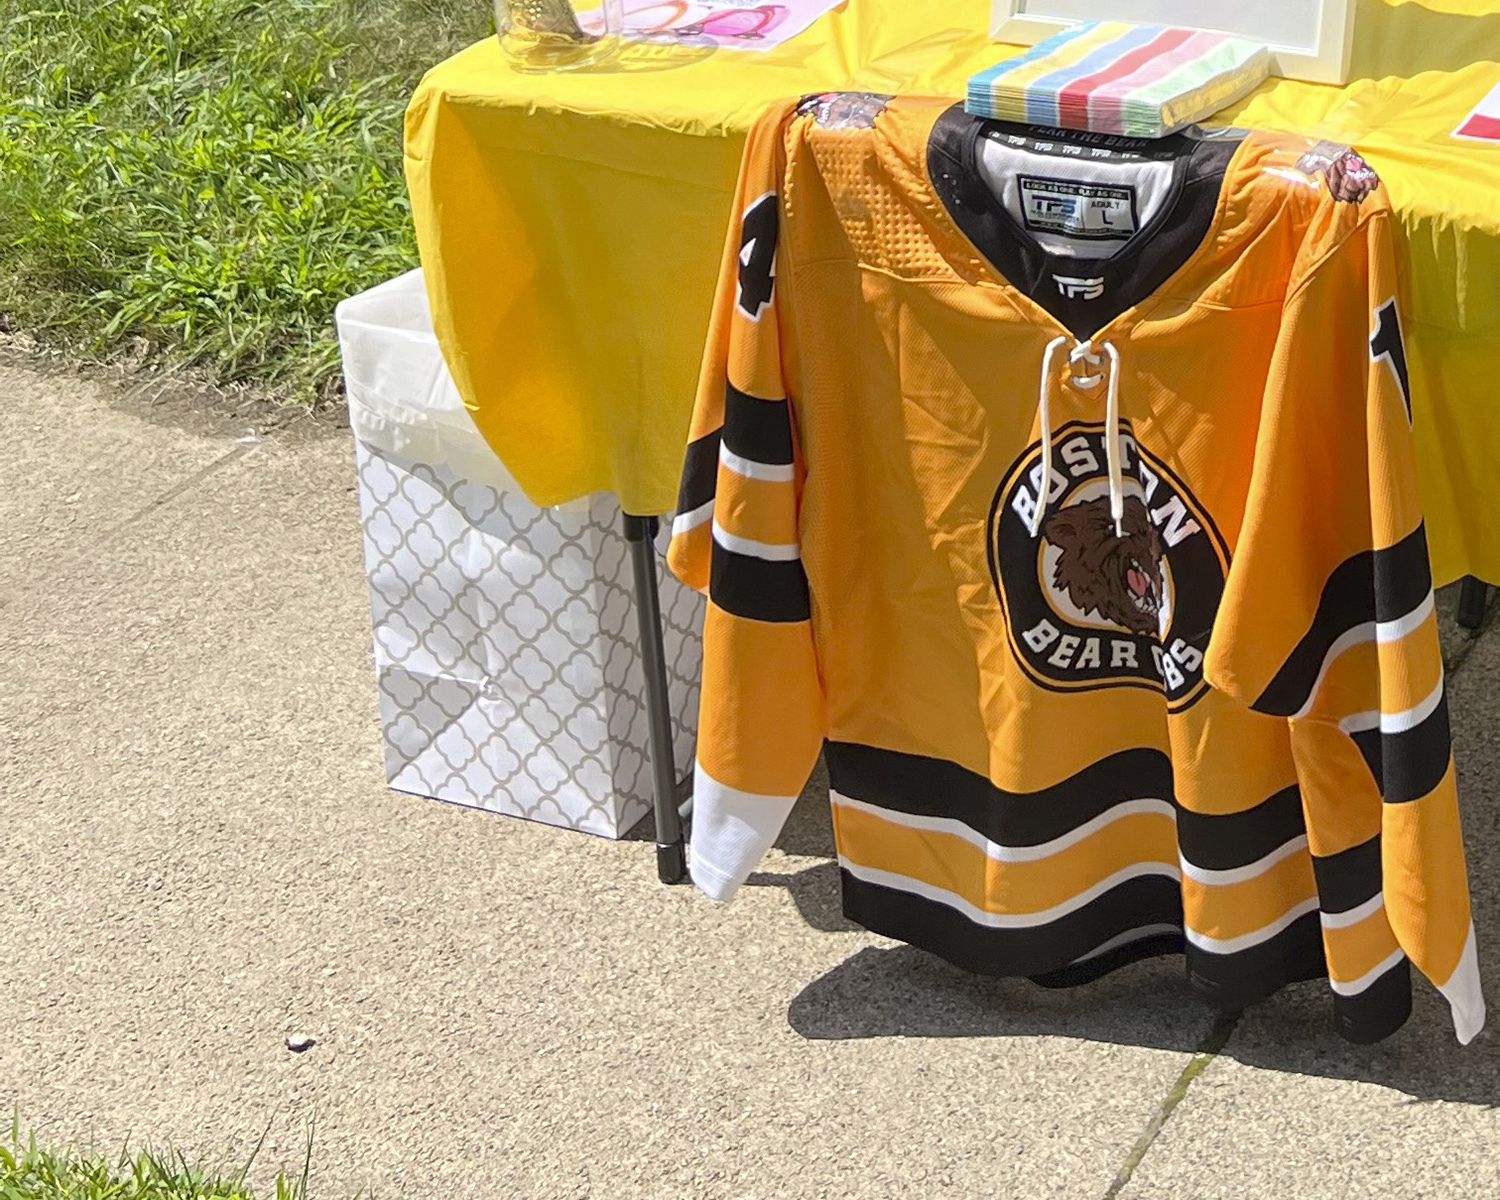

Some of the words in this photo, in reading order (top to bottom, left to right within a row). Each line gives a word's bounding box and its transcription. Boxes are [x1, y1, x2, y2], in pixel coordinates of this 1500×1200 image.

[1048, 184, 1058, 192] AS
[1097, 189, 1108, 198] AS
[1031, 194, 1077, 214] TPS
[1090, 200, 1120, 209] ADULT
[1102, 210, 1113, 226] L
[1052, 273, 1104, 300] TPS
[1022, 618, 1139, 670] BEAR
